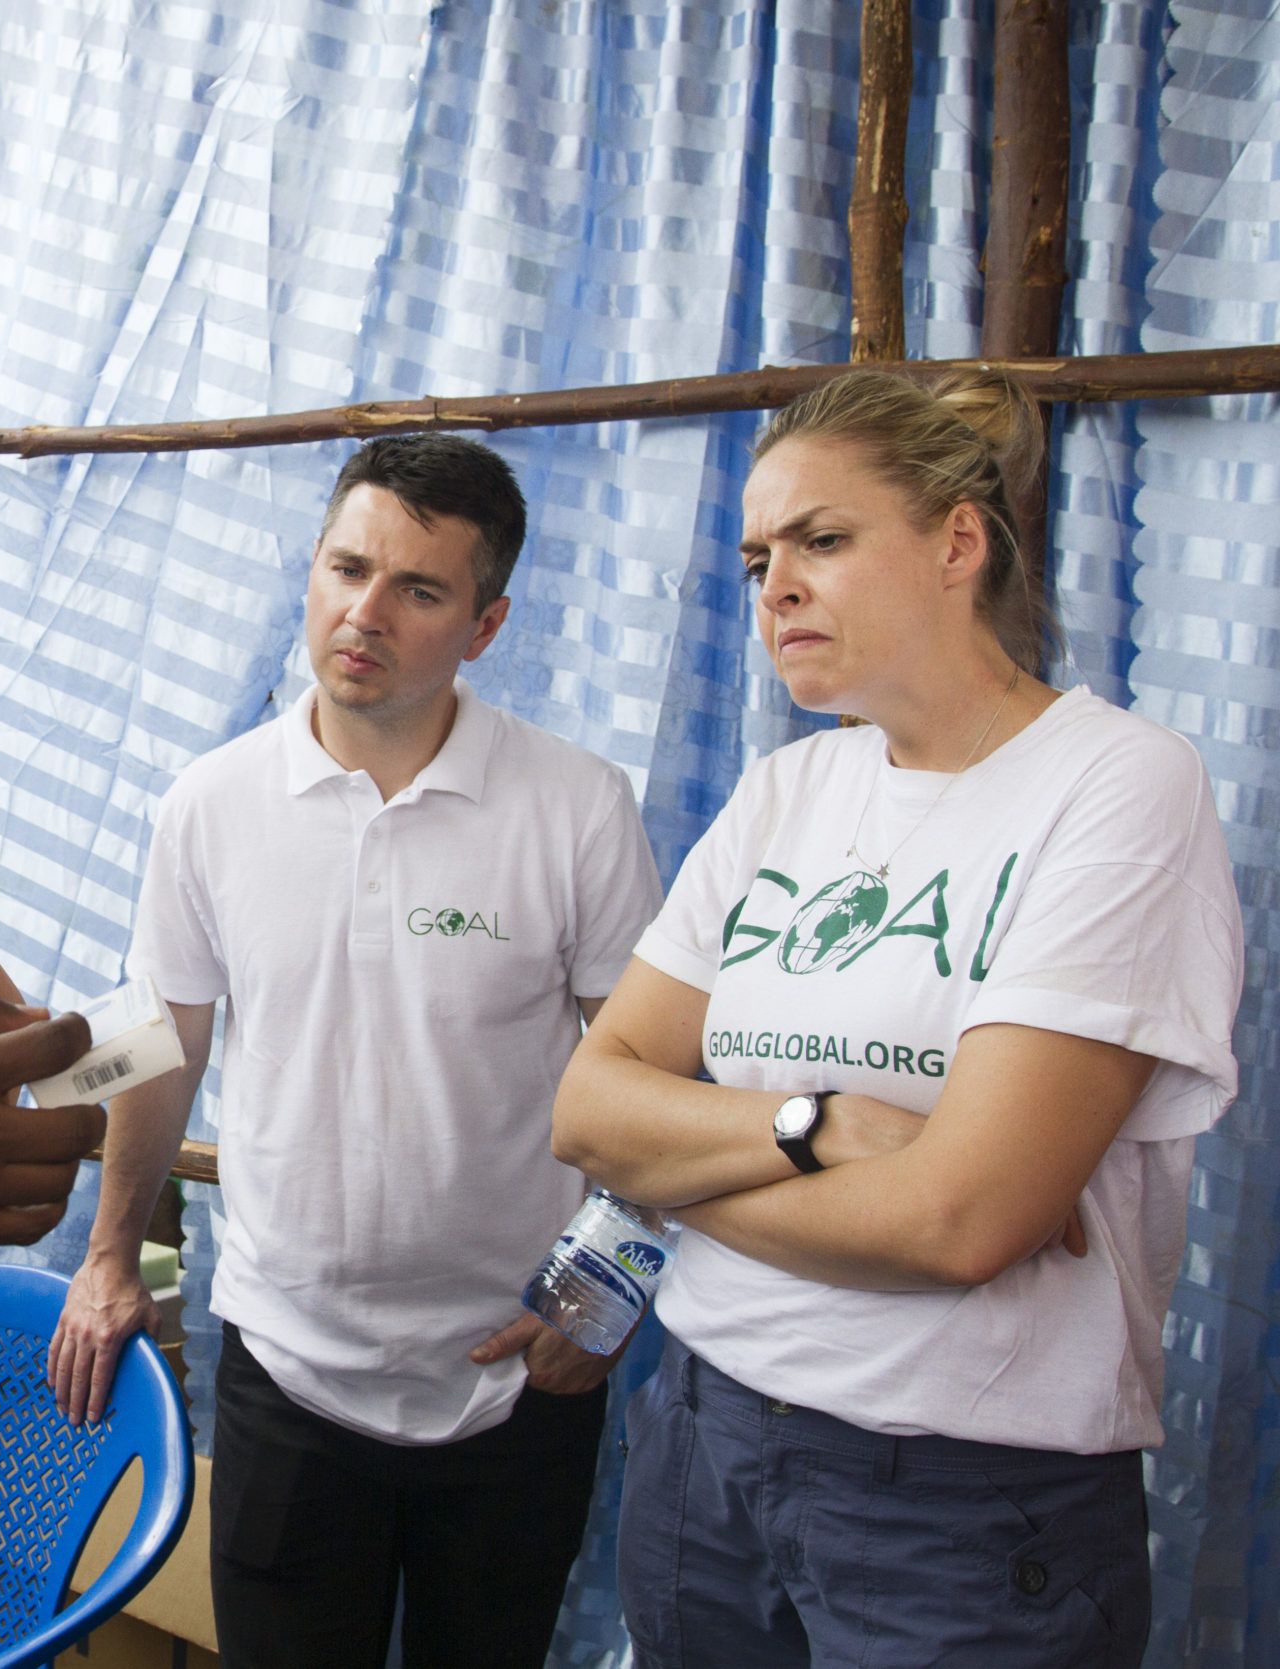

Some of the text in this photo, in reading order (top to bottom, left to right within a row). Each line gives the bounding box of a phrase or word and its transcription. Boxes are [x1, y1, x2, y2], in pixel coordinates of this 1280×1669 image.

[407, 907, 511, 940] GOAL
[722, 852, 1019, 982] GOAL
[709, 1030, 946, 1078] GOALGLOBAL.ORG
